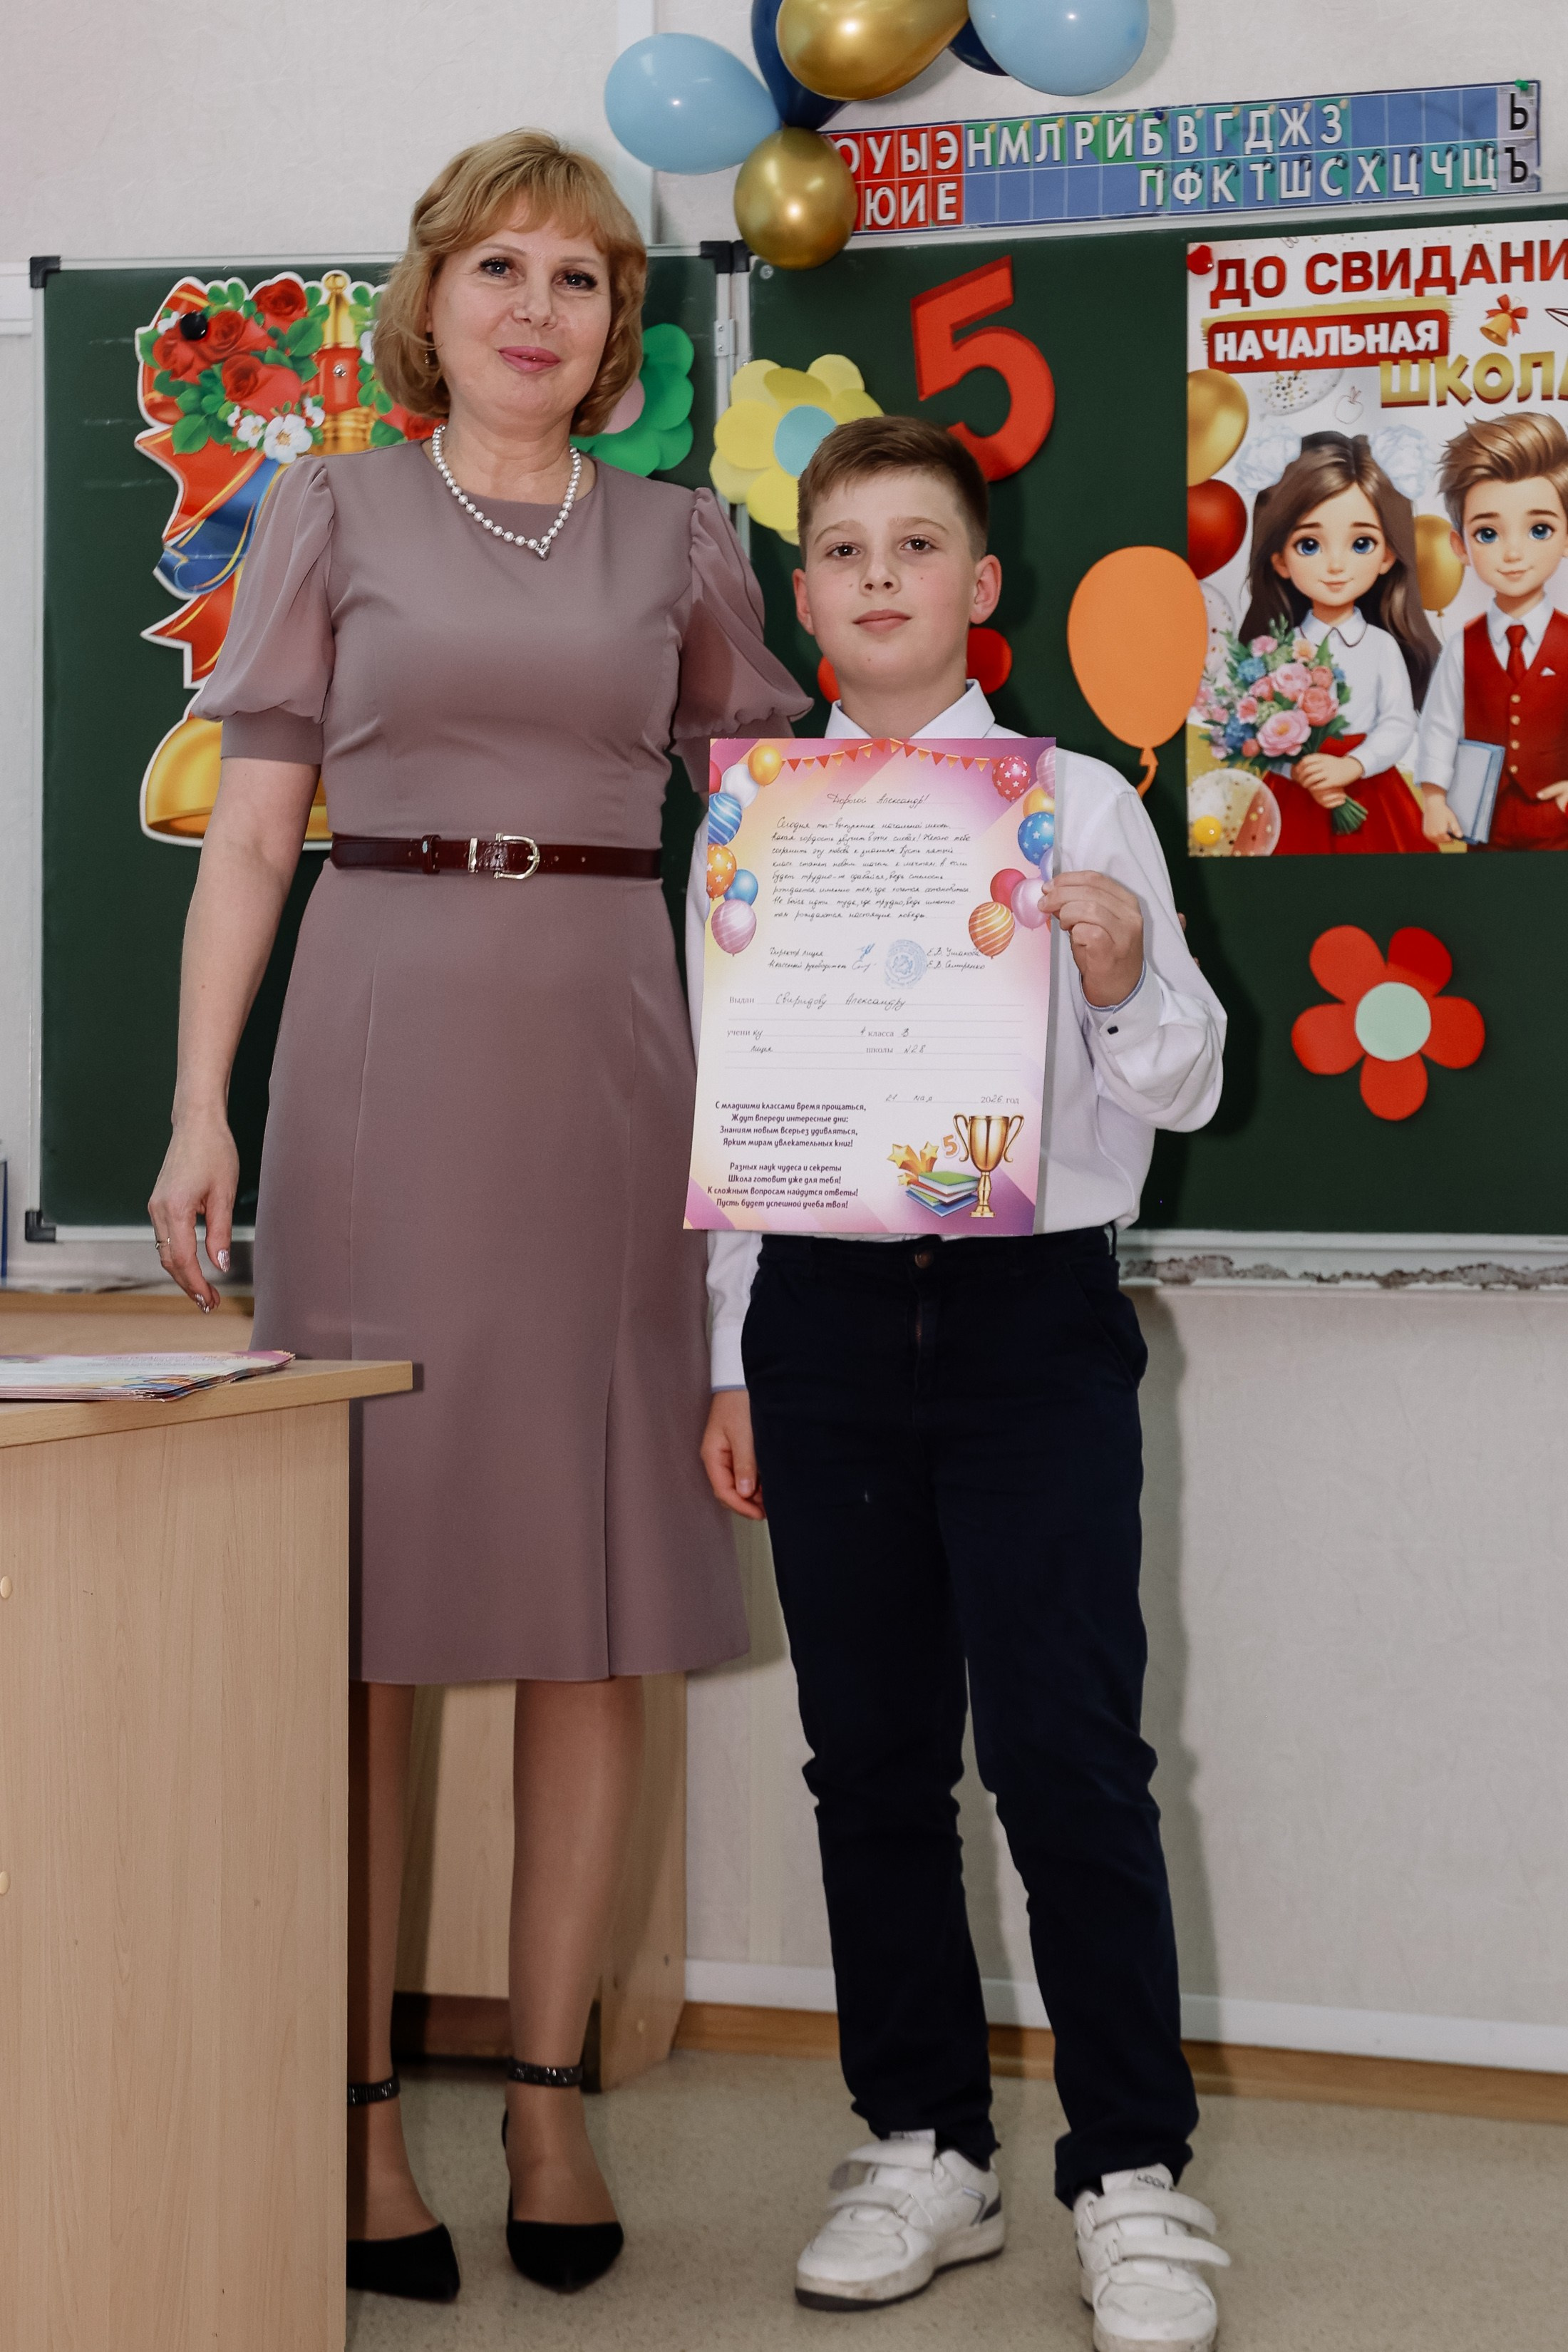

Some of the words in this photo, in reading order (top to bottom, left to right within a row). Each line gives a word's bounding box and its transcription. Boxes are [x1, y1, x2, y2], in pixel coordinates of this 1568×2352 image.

[1209, 256, 1287, 309] ДО
[1214, 319, 1440, 363] НАЧАЛЬНАЯ
[911, 255, 1055, 483] 5
[1379, 351, 1568, 409] ШКОЛ
[827, 793, 867, 809] Дорогой
[877, 793, 929, 808] Александр!
[775, 991, 827, 1009] Свиридову
[845, 993, 906, 1011] Александру
[797, 1103, 820, 1111] время
[731, 1114, 753, 1123] Ждут
[755, 1114, 785, 1123] впереди
[719, 1125, 752, 1134] Знаниям
[780, 1127, 809, 1135] всерьез
[810, 1128, 858, 1136] удивляться,
[723, 1138, 746, 1147] Ярким
[774, 1139, 832, 1148] увлекательных
[834, 1139, 853, 1147] книг!
[943, 1134, 958, 1156] 5
[730, 1162, 757, 1171] Разных
[759, 1163, 775, 1172] наук
[809, 1164, 842, 1172] секреты
[750, 1187, 785, 1197] вопросам
[787, 1188, 822, 1197] найдутся
[716, 1198, 739, 1207] Пусть
[741, 1199, 765, 1208] будет
[766, 1200, 801, 1209] успешной
[803, 1200, 825, 1209] учеба
[825, 1200, 848, 1209] твоя!
